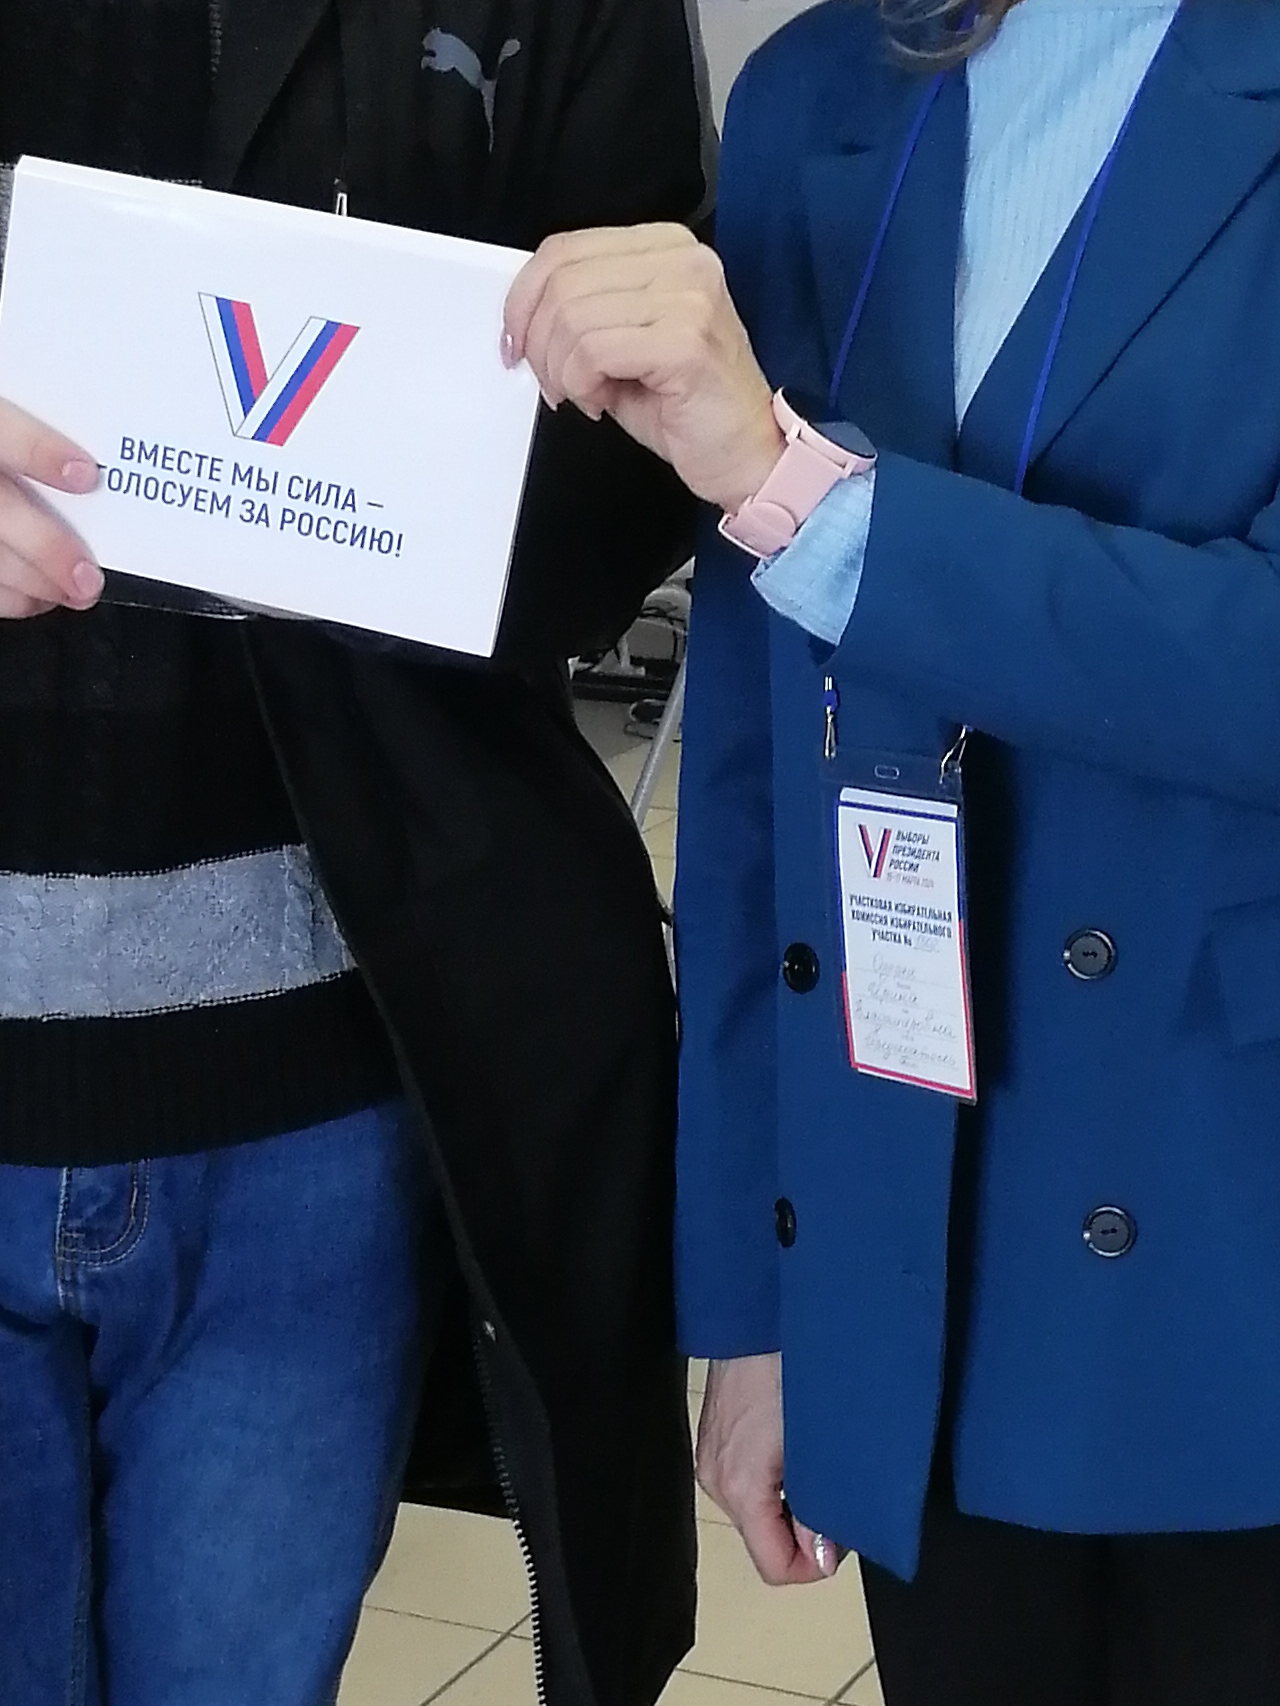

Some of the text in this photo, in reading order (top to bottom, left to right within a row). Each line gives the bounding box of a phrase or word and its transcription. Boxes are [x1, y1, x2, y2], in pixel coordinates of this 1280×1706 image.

[120, 436, 224, 482] ВМЕСТЕ
[231, 462, 280, 495] МЫ
[287, 475, 358, 513] СИЛА
[239, 499, 272, 529] ЗА
[279, 508, 404, 558] РОССИЮ!
[895, 830, 930, 845] ВЫБОРЫ
[892, 845, 940, 862] ПРЕЗИДЕНТА
[889, 858, 920, 873] РОССИИ
[849, 894, 893, 912] УЧАСТКОВАЯ
[851, 909, 888, 926] КОМИССИЯ
[872, 929, 903, 945] УЧАСТКА
